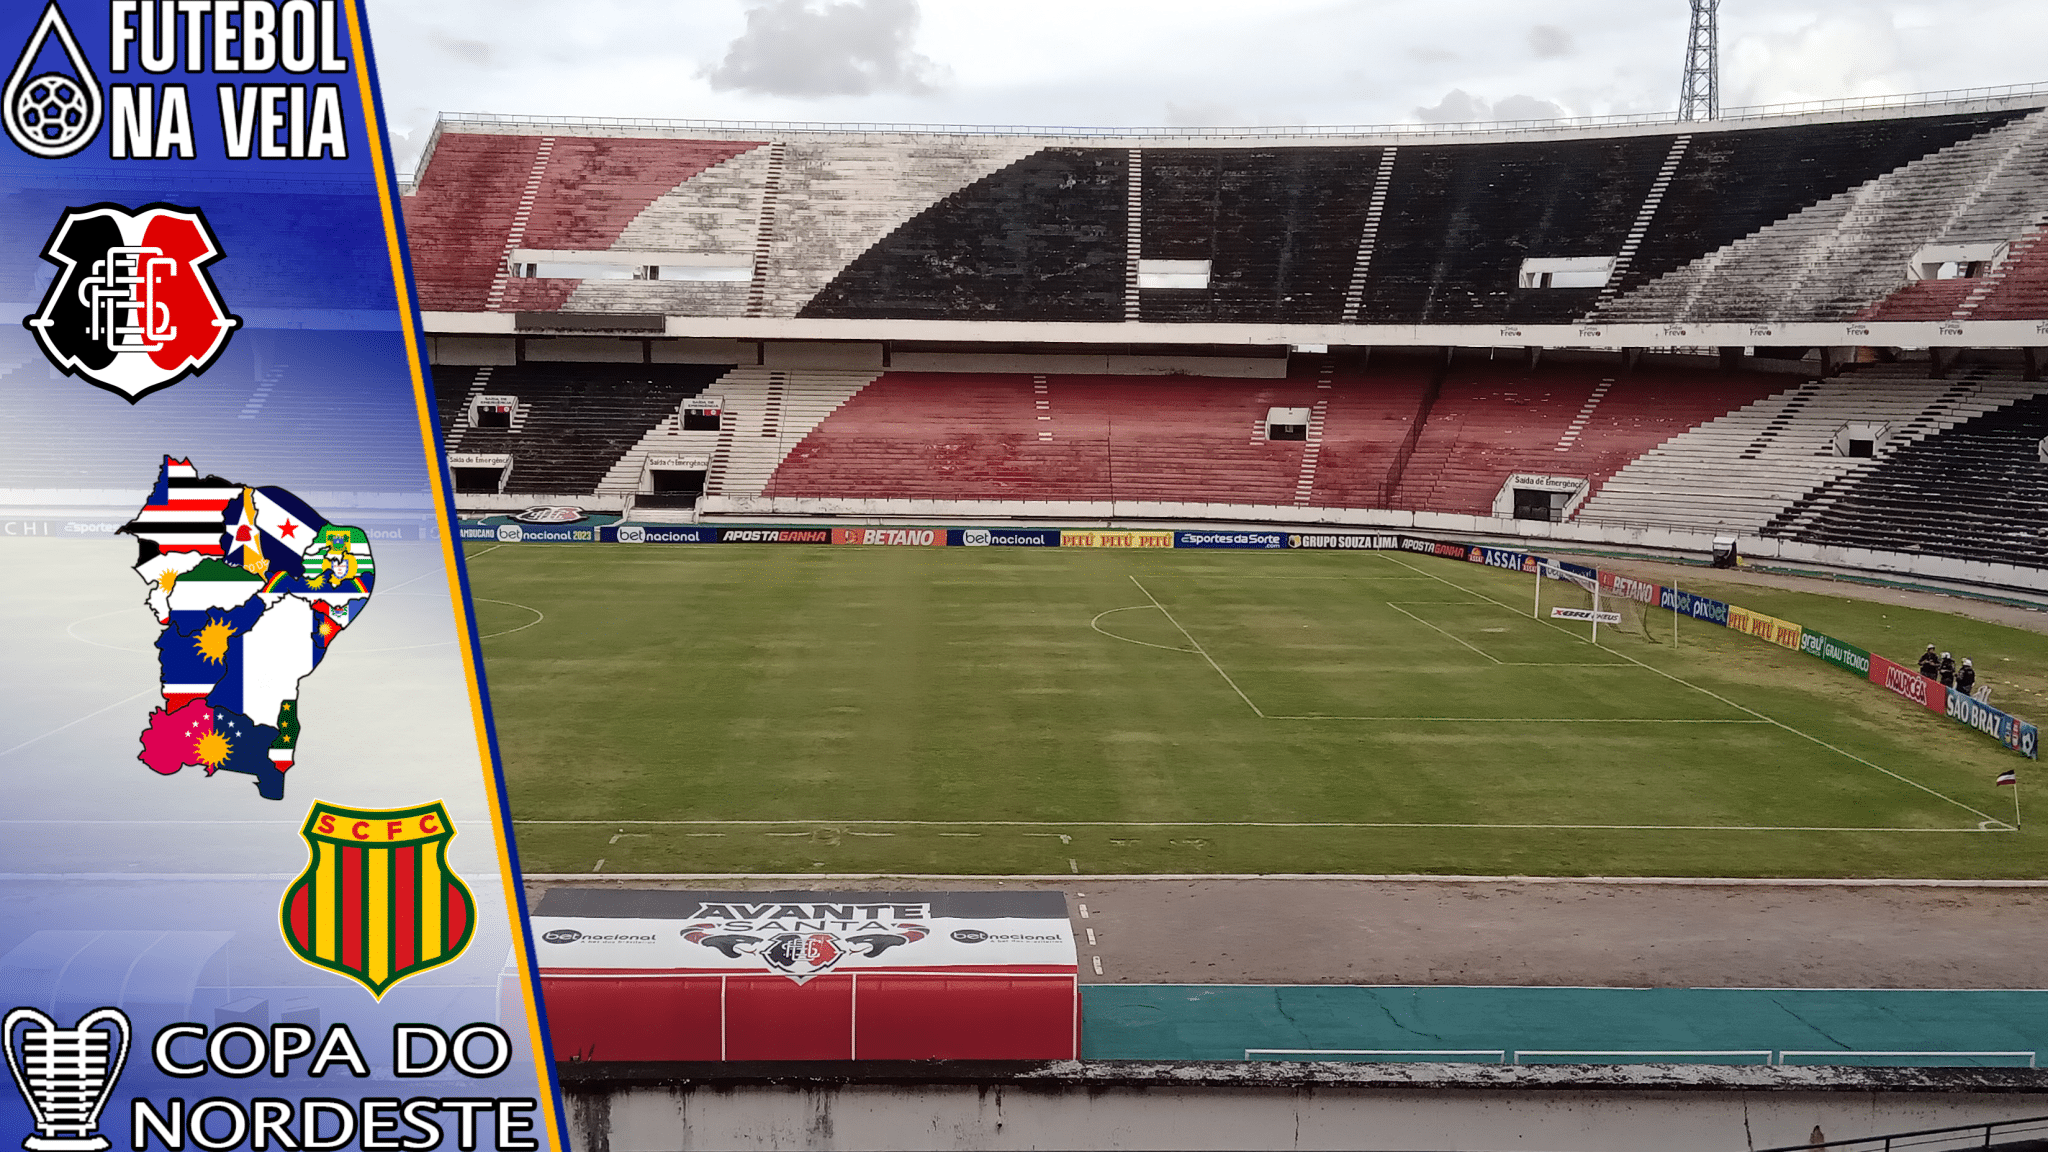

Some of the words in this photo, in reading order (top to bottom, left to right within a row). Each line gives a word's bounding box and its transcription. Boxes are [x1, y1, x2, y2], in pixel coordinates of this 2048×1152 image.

[1536, 477, 1544, 485] de
[573, 530, 592, 540] 2023
[863, 529, 934, 546] BETANO
[1303, 536, 1336, 548] GRUPO
[1338, 536, 1372, 548] SOUZA
[1373, 536, 1398, 549] LIMA
[1614, 576, 1653, 603] BETANO
[1693, 597, 1727, 622] pixbet
[1826, 643, 1844, 661] GRAU
[1844, 648, 1869, 672] TÉCNICO
[1971, 704, 2001, 739] BRAZ
[698, 903, 927, 920] AVANTE
[724, 920, 889, 932] SANTA
